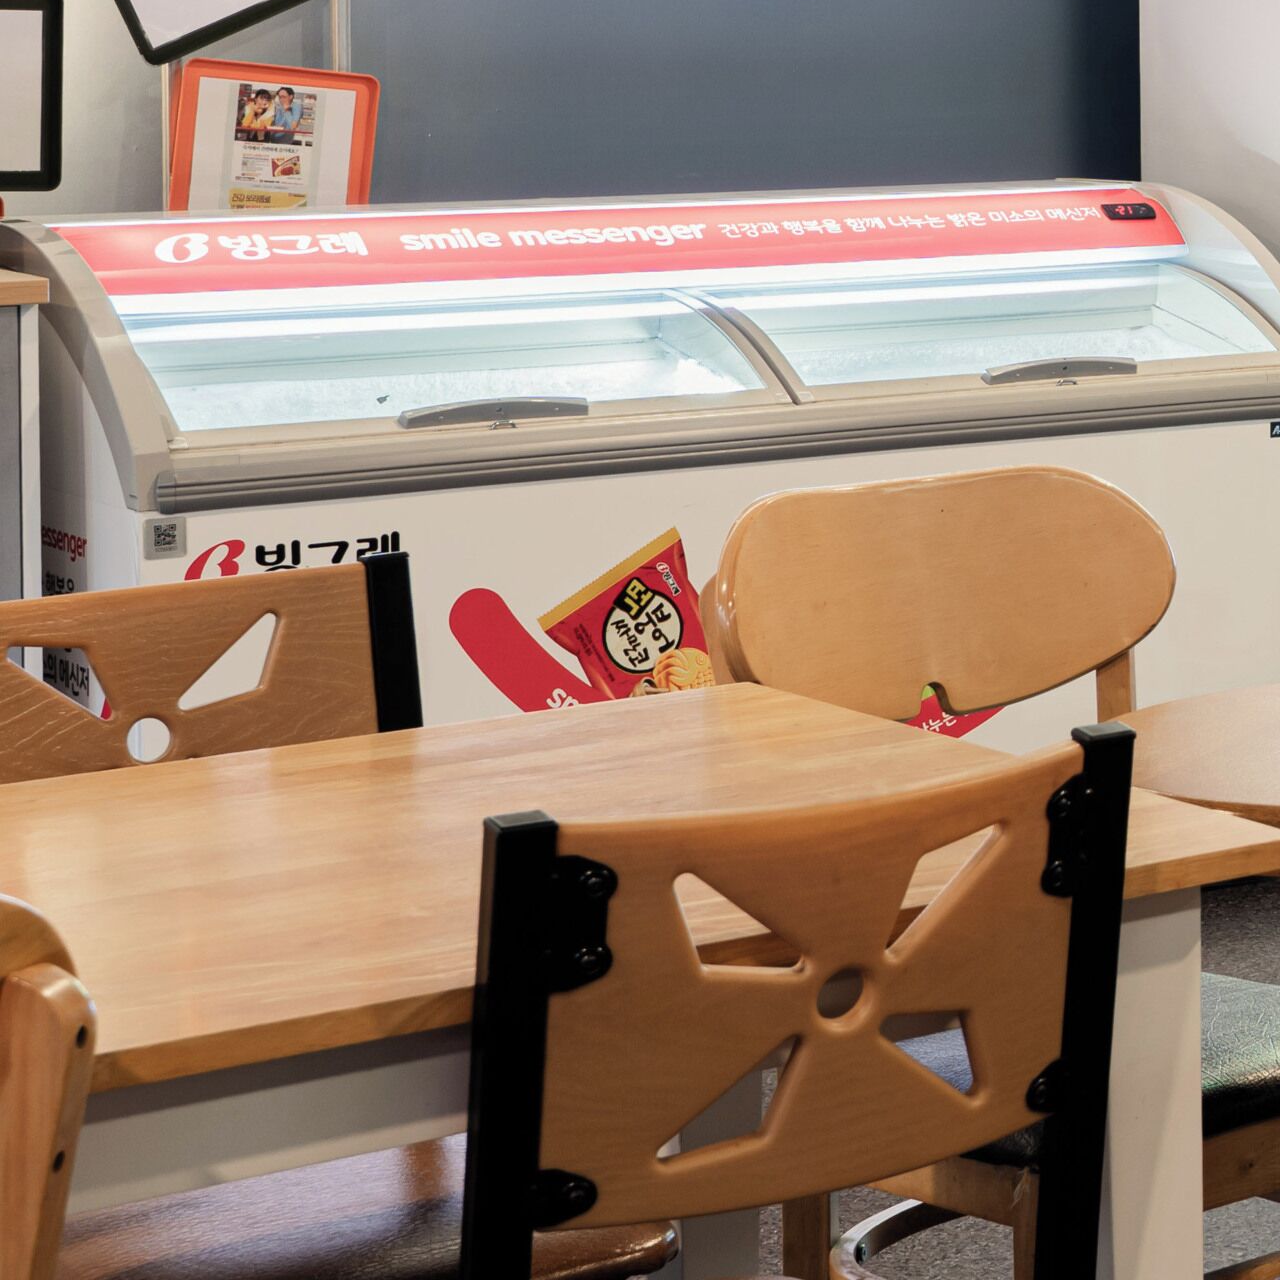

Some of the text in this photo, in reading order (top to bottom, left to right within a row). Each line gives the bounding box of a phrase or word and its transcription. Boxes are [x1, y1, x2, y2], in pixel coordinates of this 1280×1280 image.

[217, 230, 369, 261] 빙그레
[399, 227, 501, 251] smile
[508, 219, 706, 248] messenger
[718, 221, 780, 239] 건강과
[782, 218, 842, 236] 행복을
[844, 215, 885, 233] 함께
[886, 213, 946, 230] 나누는
[946, 212, 987, 228] 밝은
[988, 209, 1045, 224] 미소의
[1045, 206, 1102, 222] 메신저
[611, 619, 651, 668] 싸만코
[59, 658, 90, 697] 메신저
